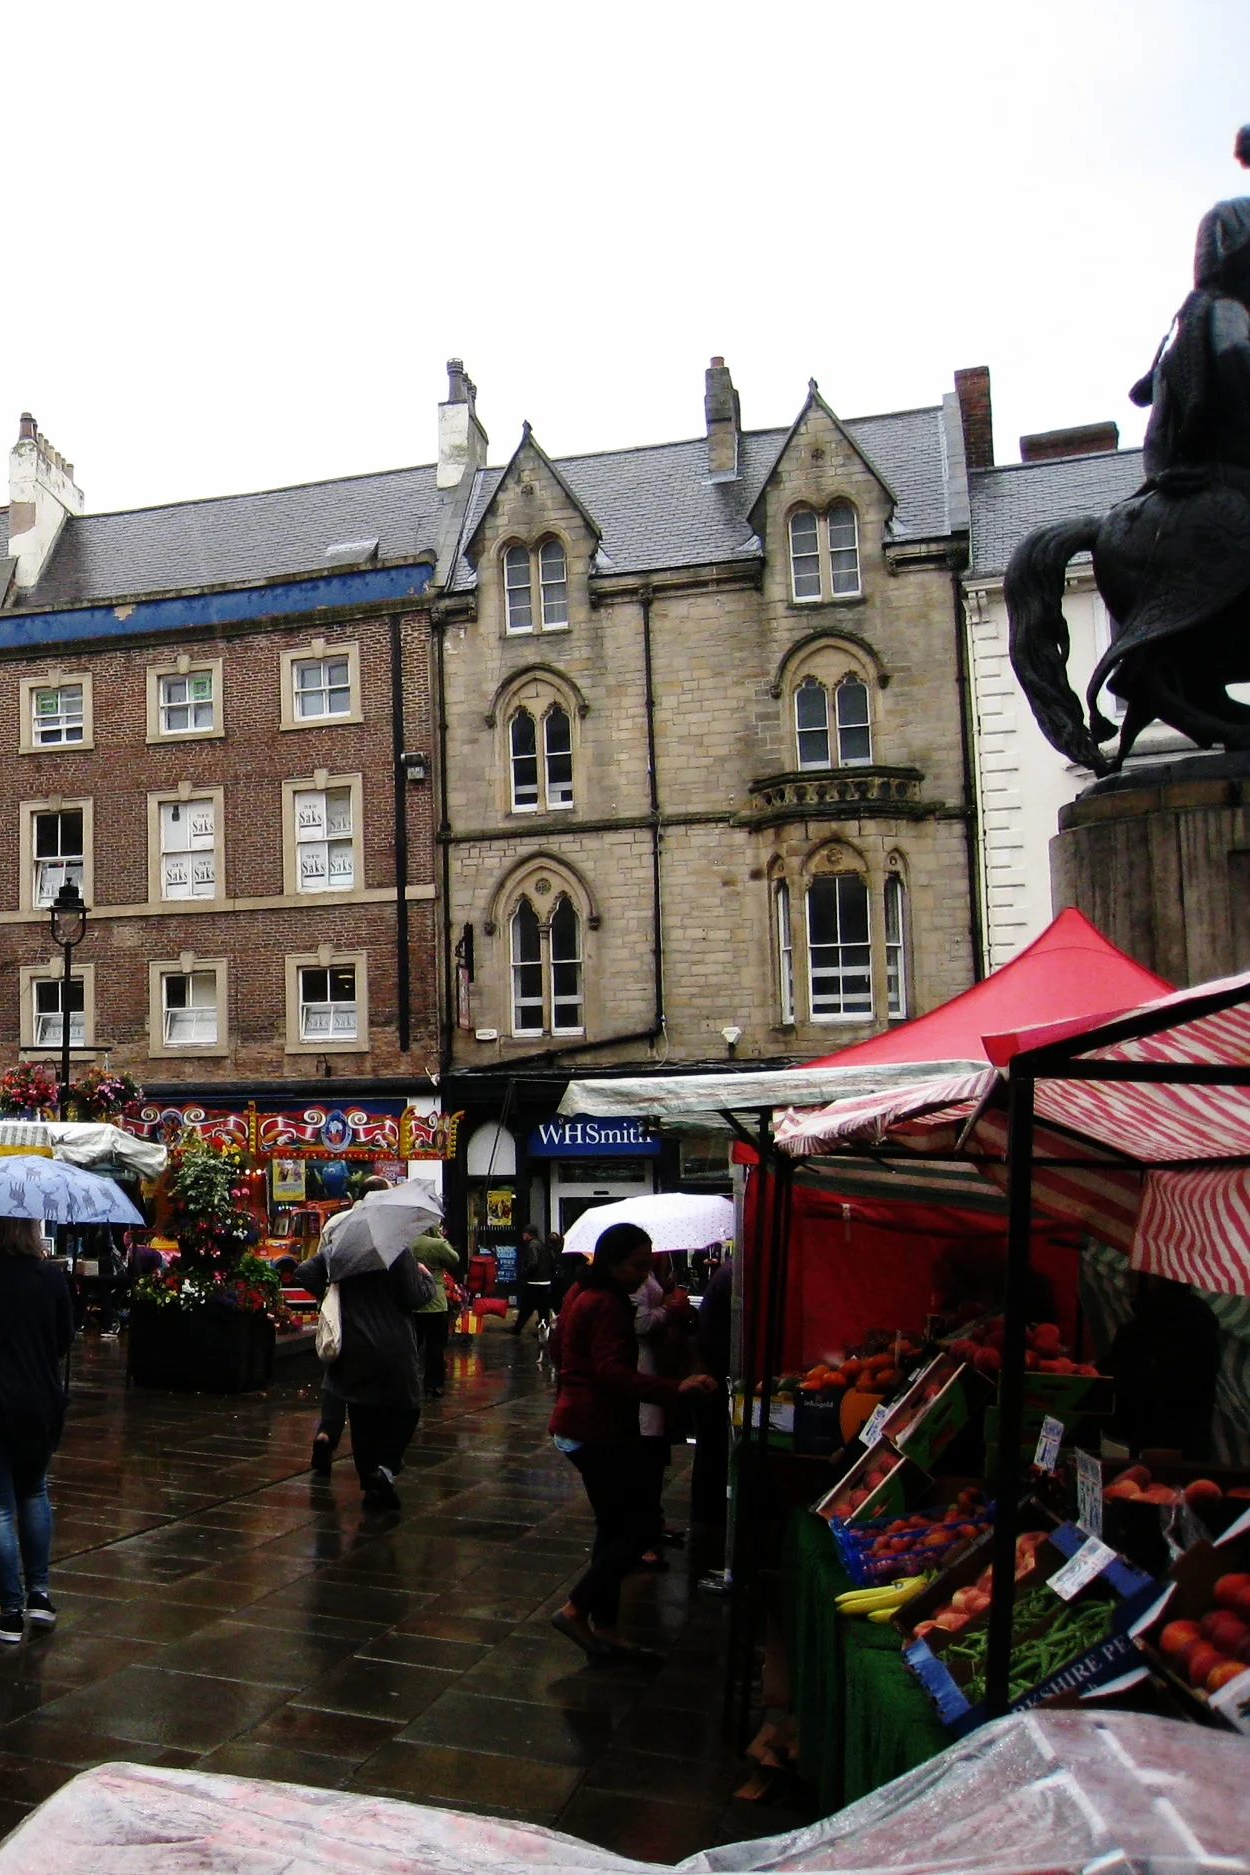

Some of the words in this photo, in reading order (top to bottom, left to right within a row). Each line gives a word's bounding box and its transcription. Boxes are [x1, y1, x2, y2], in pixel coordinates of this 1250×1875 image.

[298, 810, 322, 824] Saks
[192, 819, 214, 833] Saks
[302, 860, 325, 874] Saks
[330, 859, 352, 873] Saks
[166, 868, 188, 881] Saks
